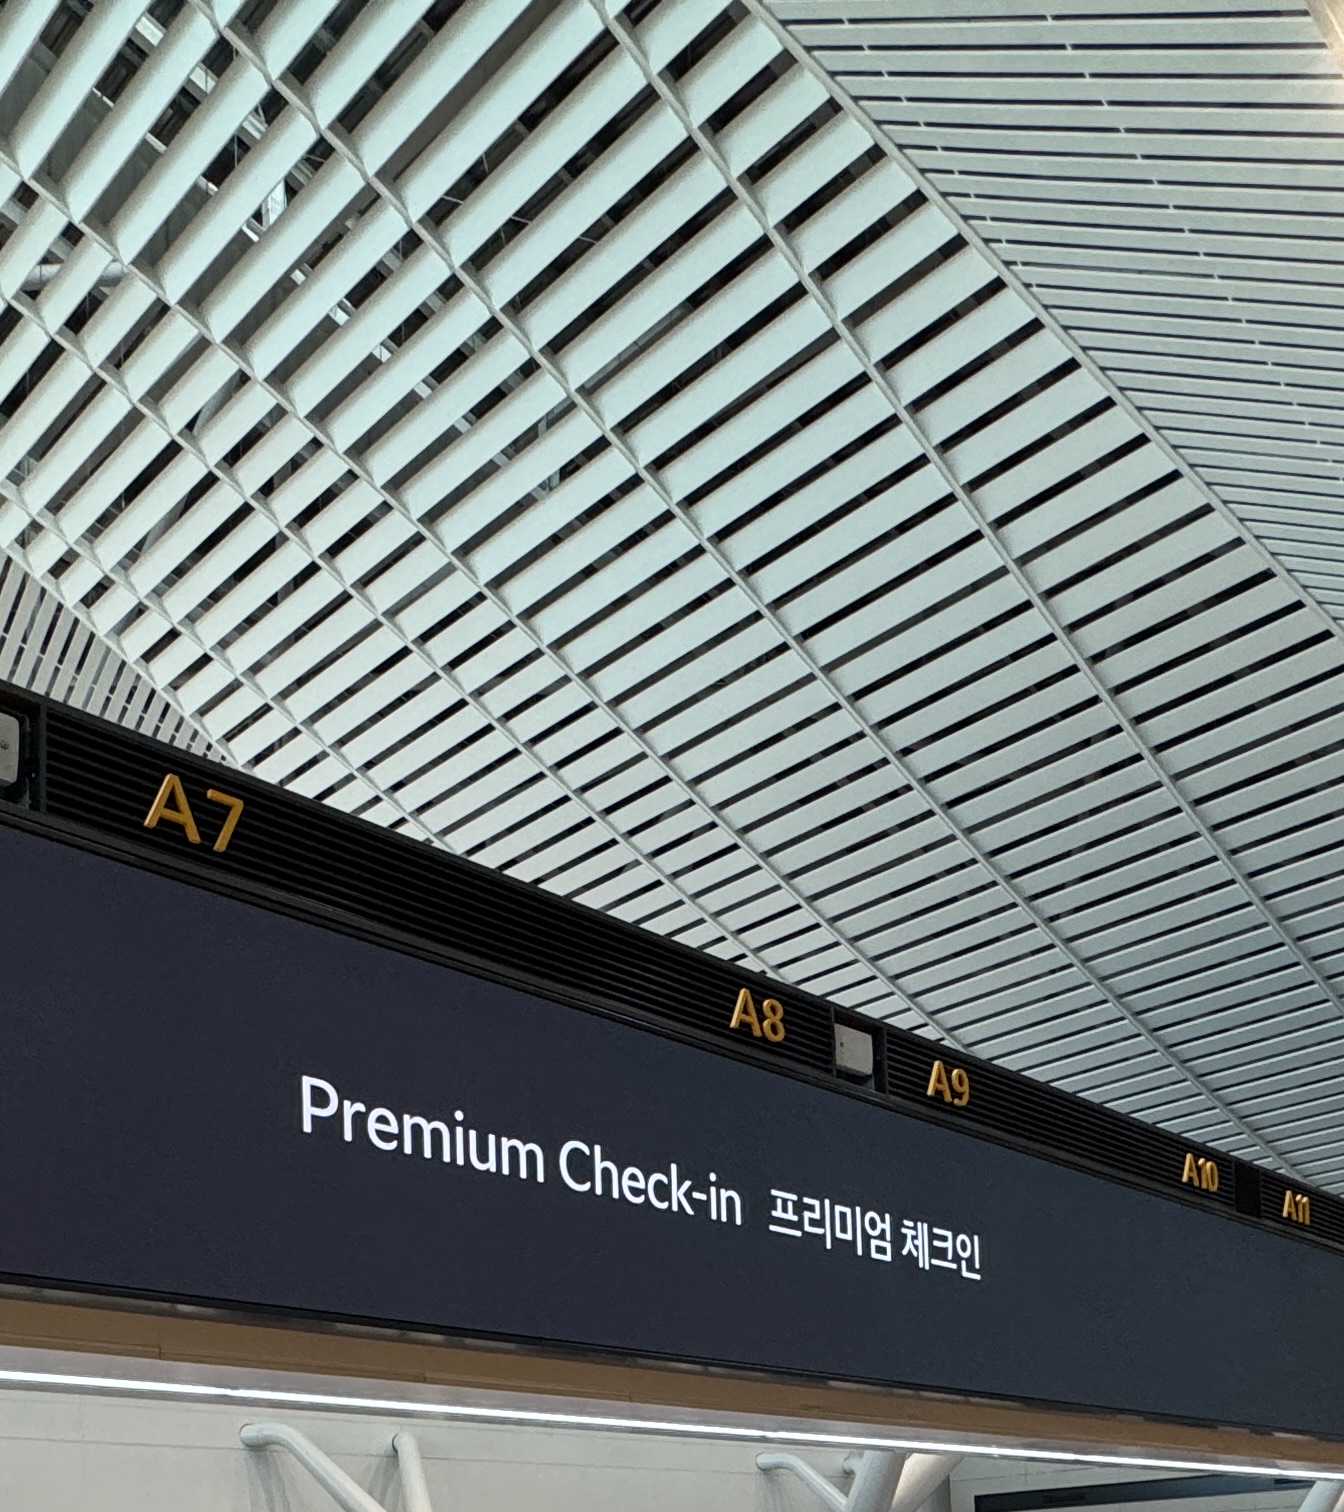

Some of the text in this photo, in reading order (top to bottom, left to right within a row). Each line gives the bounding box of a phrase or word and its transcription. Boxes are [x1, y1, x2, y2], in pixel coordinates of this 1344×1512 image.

[143, 773, 244, 852] A7
[730, 987, 786, 1042] A8
[927, 1060, 970, 1106] A9
[300, 1074, 742, 1226] Premium Check-in
[1182, 1153, 1219, 1192] A10
[768, 1188, 982, 1281] 프리미엄 체크인
[1282, 1190, 1311, 1225] A11
